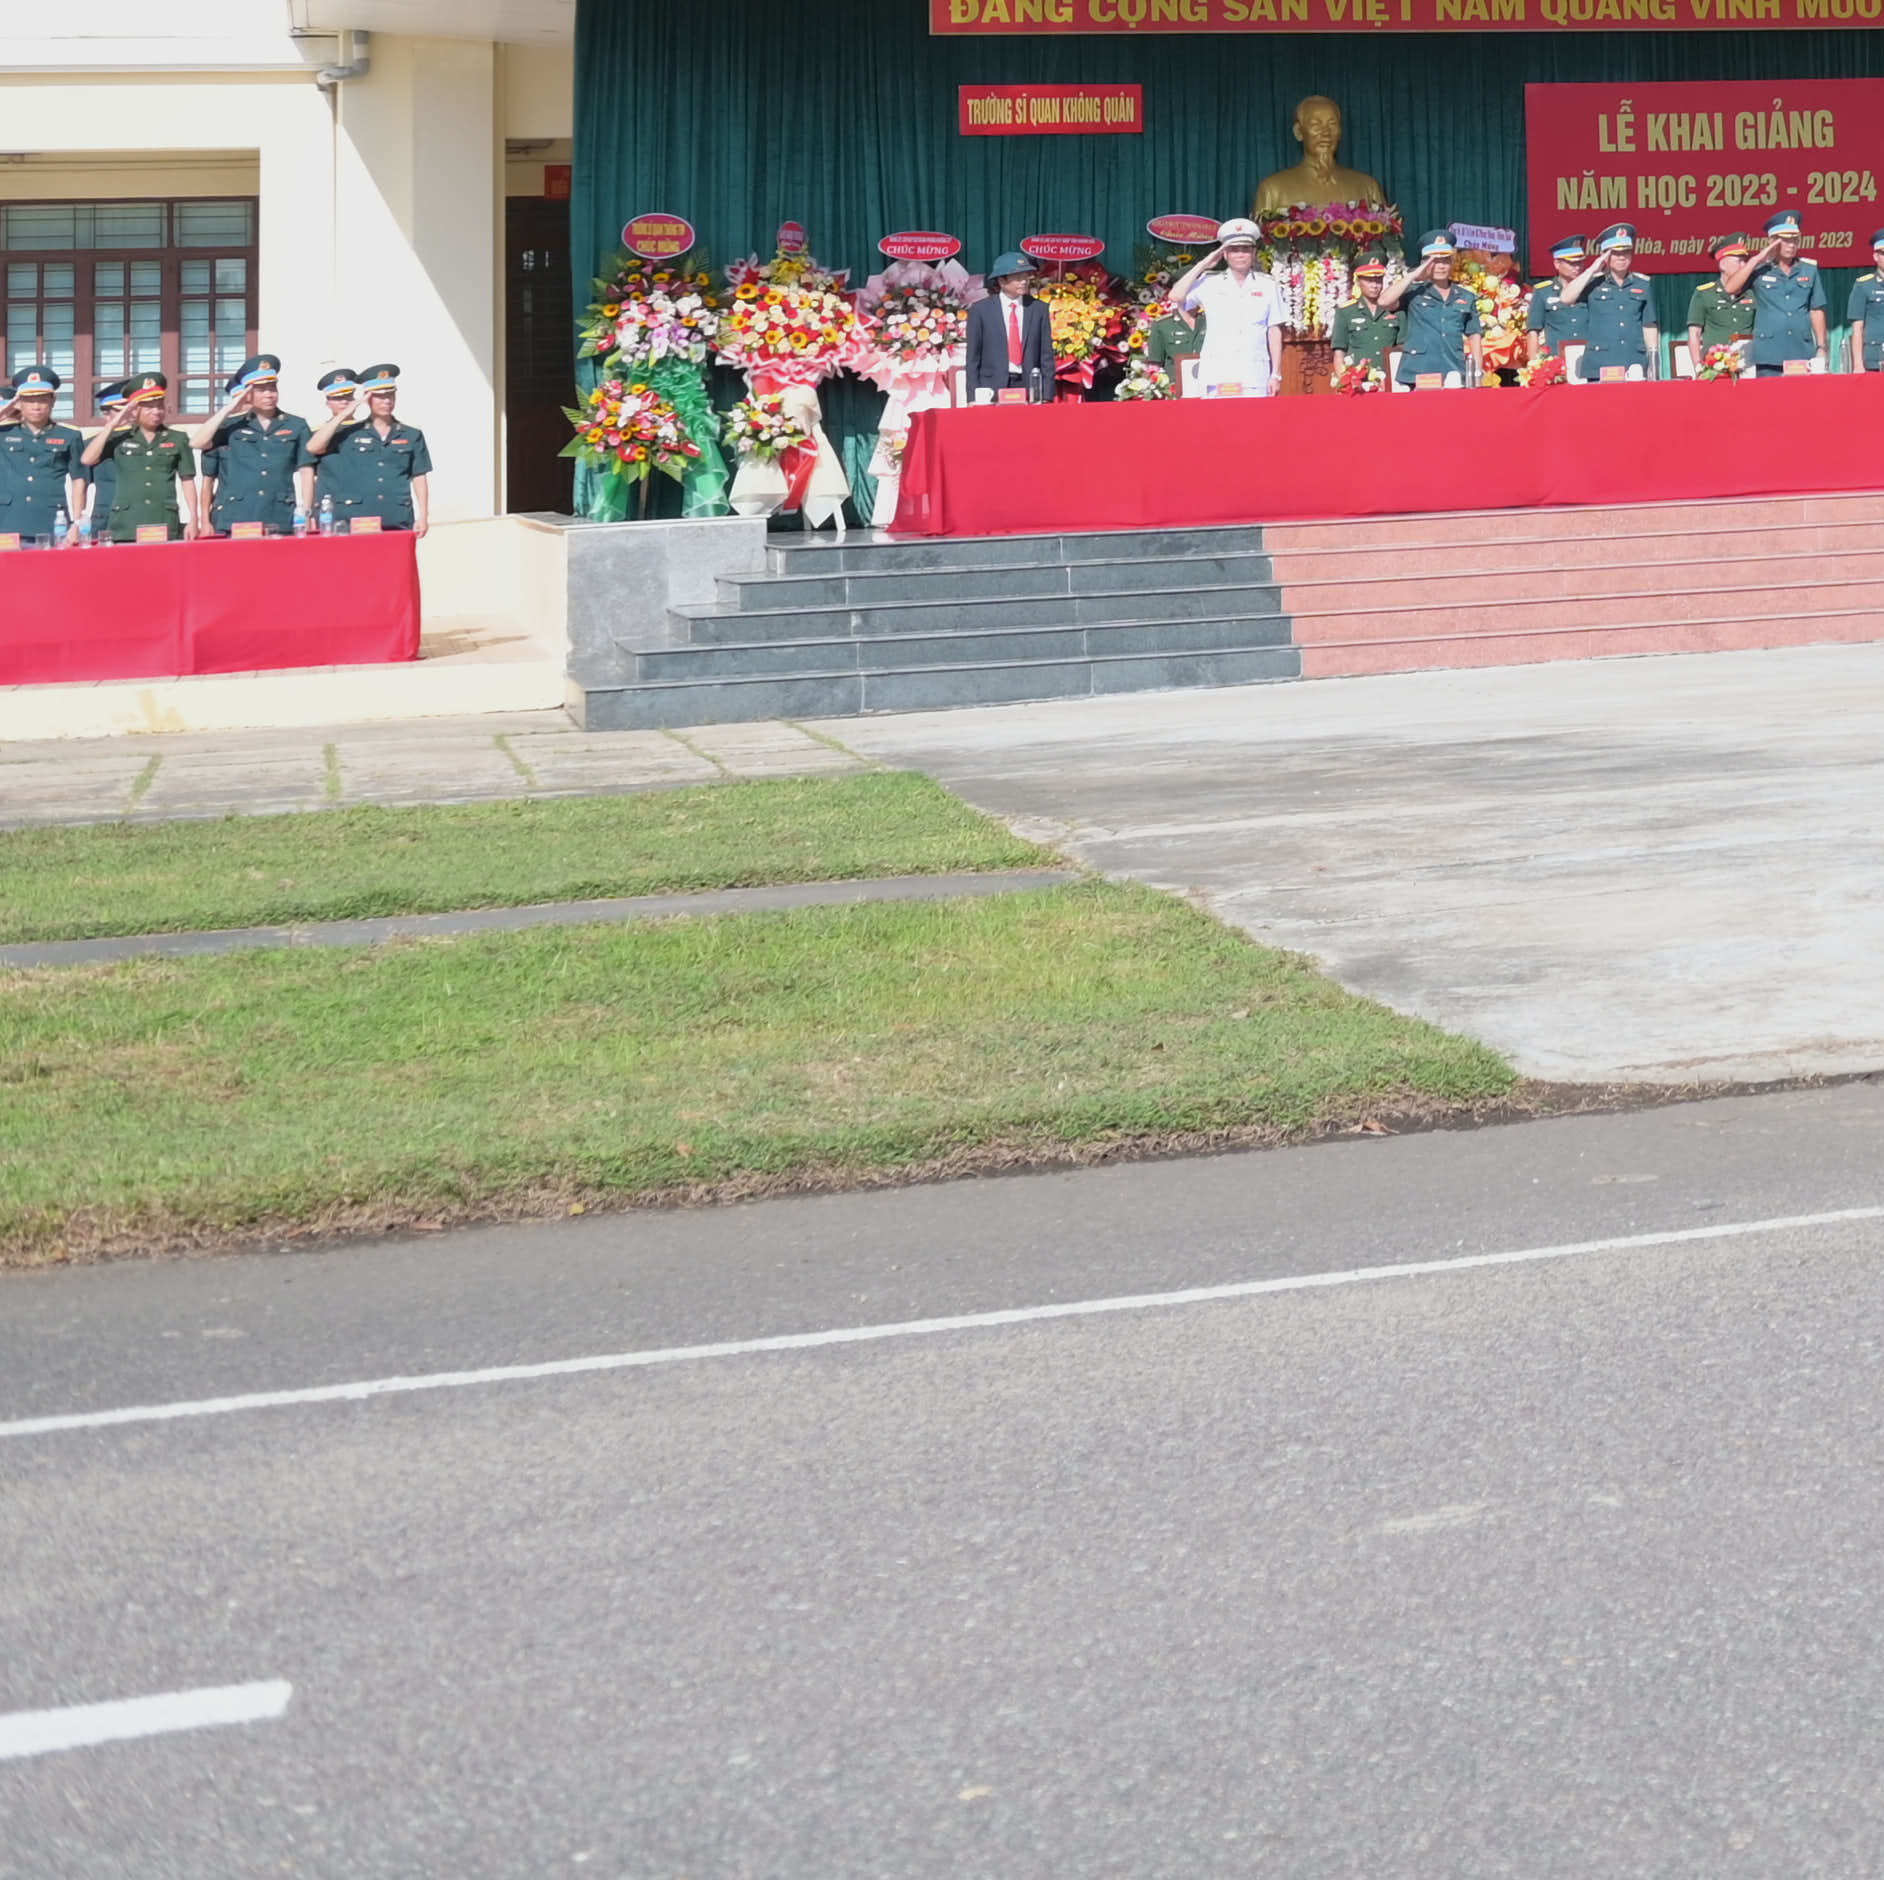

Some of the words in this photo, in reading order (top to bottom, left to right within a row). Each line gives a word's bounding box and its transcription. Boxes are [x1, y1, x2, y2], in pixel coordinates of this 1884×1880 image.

[967, 92, 1013, 125] TRƯỜNG
[1030, 97, 1060, 126] QUAN
[1063, 92, 1100, 123] KHÔNG
[1104, 92, 1134, 125] QUÂN
[1598, 99, 1636, 152] LỄ
[1647, 112, 1724, 151] KHAI
[1735, 98, 1834, 150] GIẢNG
[1557, 169, 1627, 210] NĂM
[1637, 174, 1697, 215] HỌC
[1706, 173, 1777, 207] 2023
[1786, 186, 1798, 194] -
[1807, 170, 1877, 204] 2024
[886, 244, 914, 255] CHÚC
[1028, 243, 1057, 255] CHÚC
[1819, 231, 1853, 249] 2023
